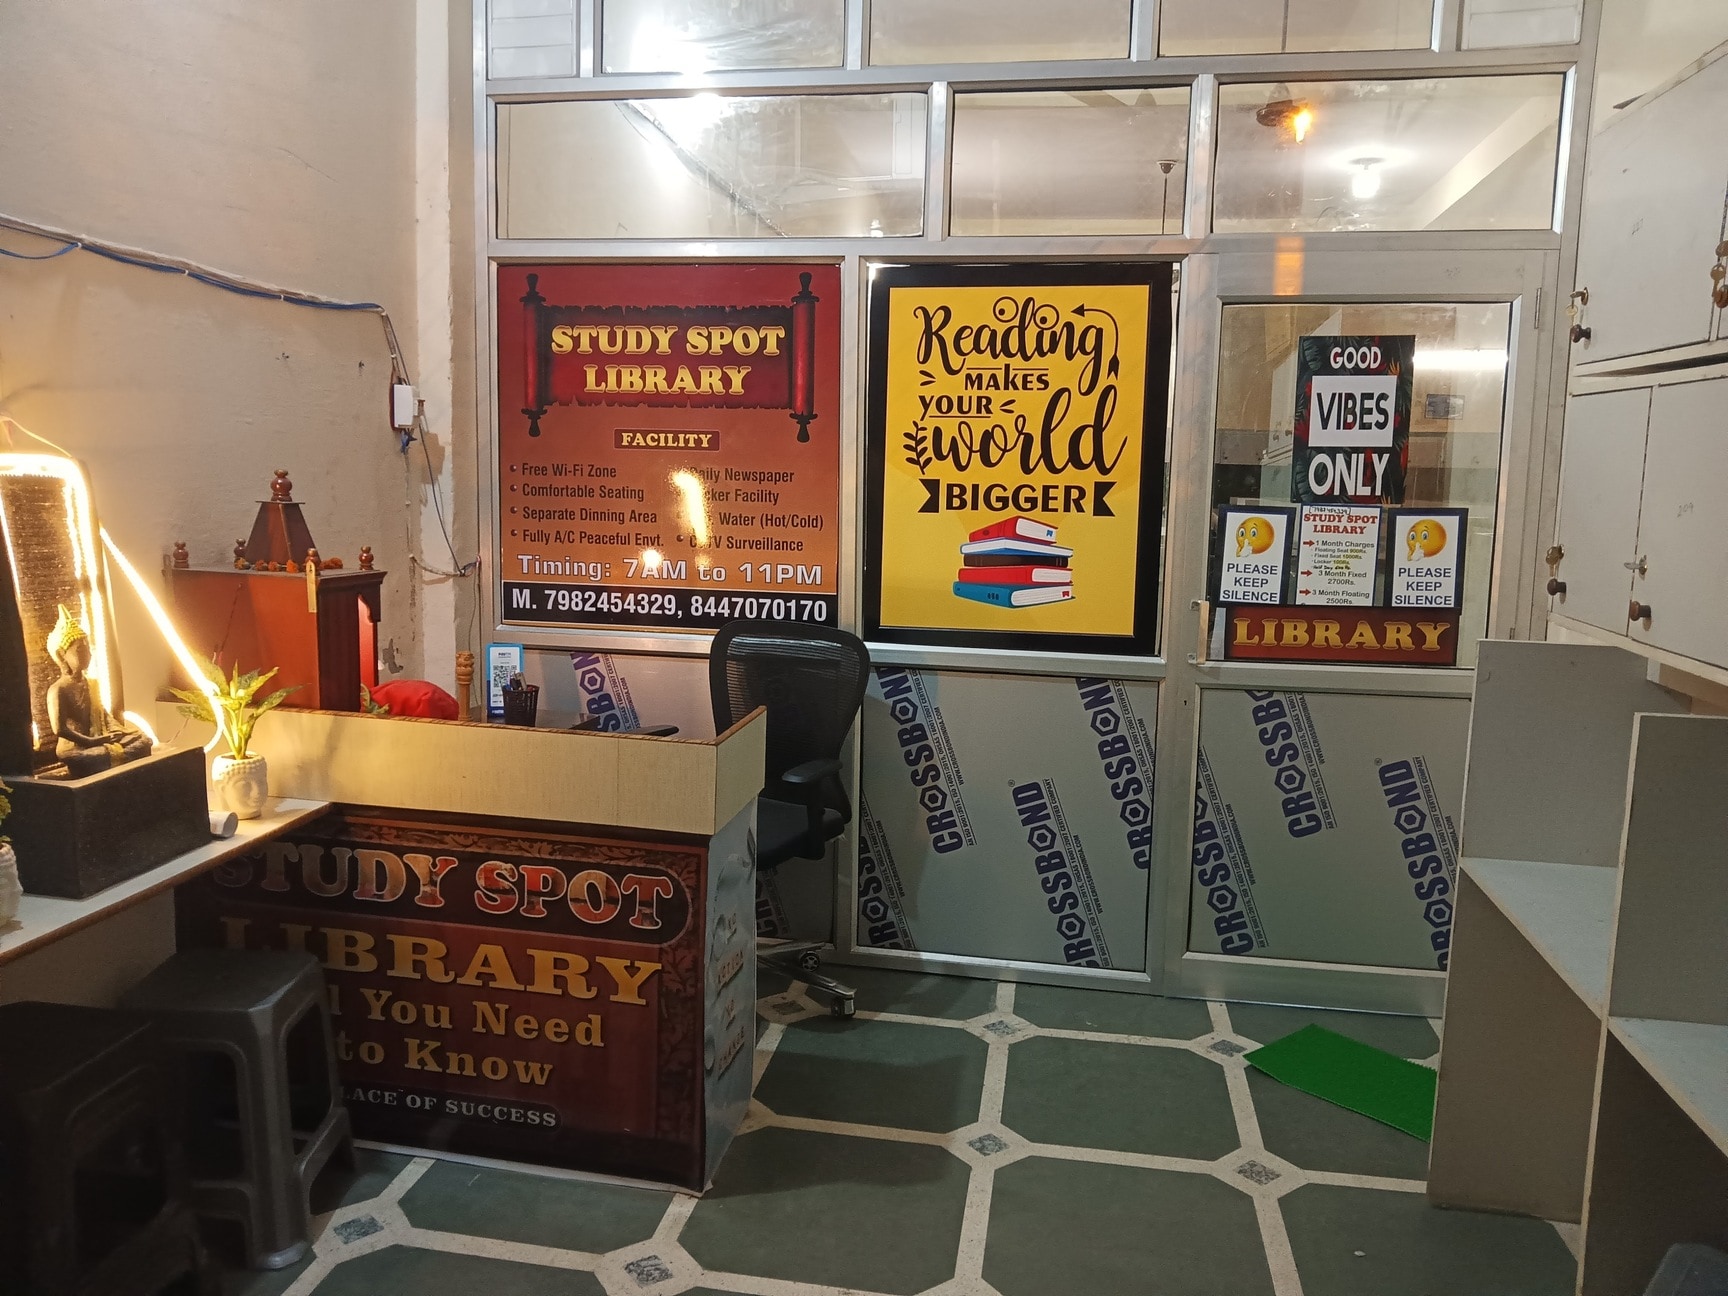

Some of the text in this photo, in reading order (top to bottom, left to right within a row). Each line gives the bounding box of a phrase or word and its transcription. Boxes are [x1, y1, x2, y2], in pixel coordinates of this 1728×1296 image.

[551, 325, 786, 356] STUDY SPOT
[914, 296, 1104, 397] Reading
[1330, 346, 1381, 370] GOOD
[583, 364, 752, 395] LIBRARY
[1316, 392, 1390, 431] VIBES
[621, 432, 713, 448] FACILITY
[932, 384, 1128, 476] world
[522, 463, 617, 478] Free Wi-Fi Zone
[725, 468, 795, 485] Newspaper
[1308, 453, 1390, 496] ONLY
[522, 484, 645, 502] Comfortable Seating
[735, 489, 780, 506] Facility
[945, 483, 1087, 513] BIGGER
[523, 506, 658, 525] Separate Dinning Area
[719, 512, 756, 527] Water
[760, 513, 824, 531] (Hot/Cold)
[1303, 513, 1378, 524] STUDY SPOT
[523, 529, 664, 547] Fully A/C Peaceful Envt.
[1313, 525, 1367, 534] LIBRARY
[726, 535, 804, 551] Surveillance
[517, 554, 823, 586] Timing: 7AM to 11PM
[1226, 563, 1278, 576] PLEASE
[1398, 567, 1452, 579] PLEASE
[1233, 577, 1269, 589] KEEP
[1406, 581, 1442, 592] KEEP
[512, 588, 828, 622] M. 7982454329, 8447070170
[1222, 589, 1278, 603] SILENCE
[1394, 594, 1453, 606] SILENCE
[1233, 617, 1451, 651] LIBRARY
[1245, 690, 1323, 838] CROSSB
[213, 841, 674, 930] STUDY SPOT
[221, 916, 662, 1006] LIBRARY
[360, 987, 452, 1029] You
[473, 1001, 605, 1047] Need
[336, 1032, 554, 1086] to Know
[406, 1094, 437, 1112] OF
[446, 1099, 557, 1128] SUCCESS
